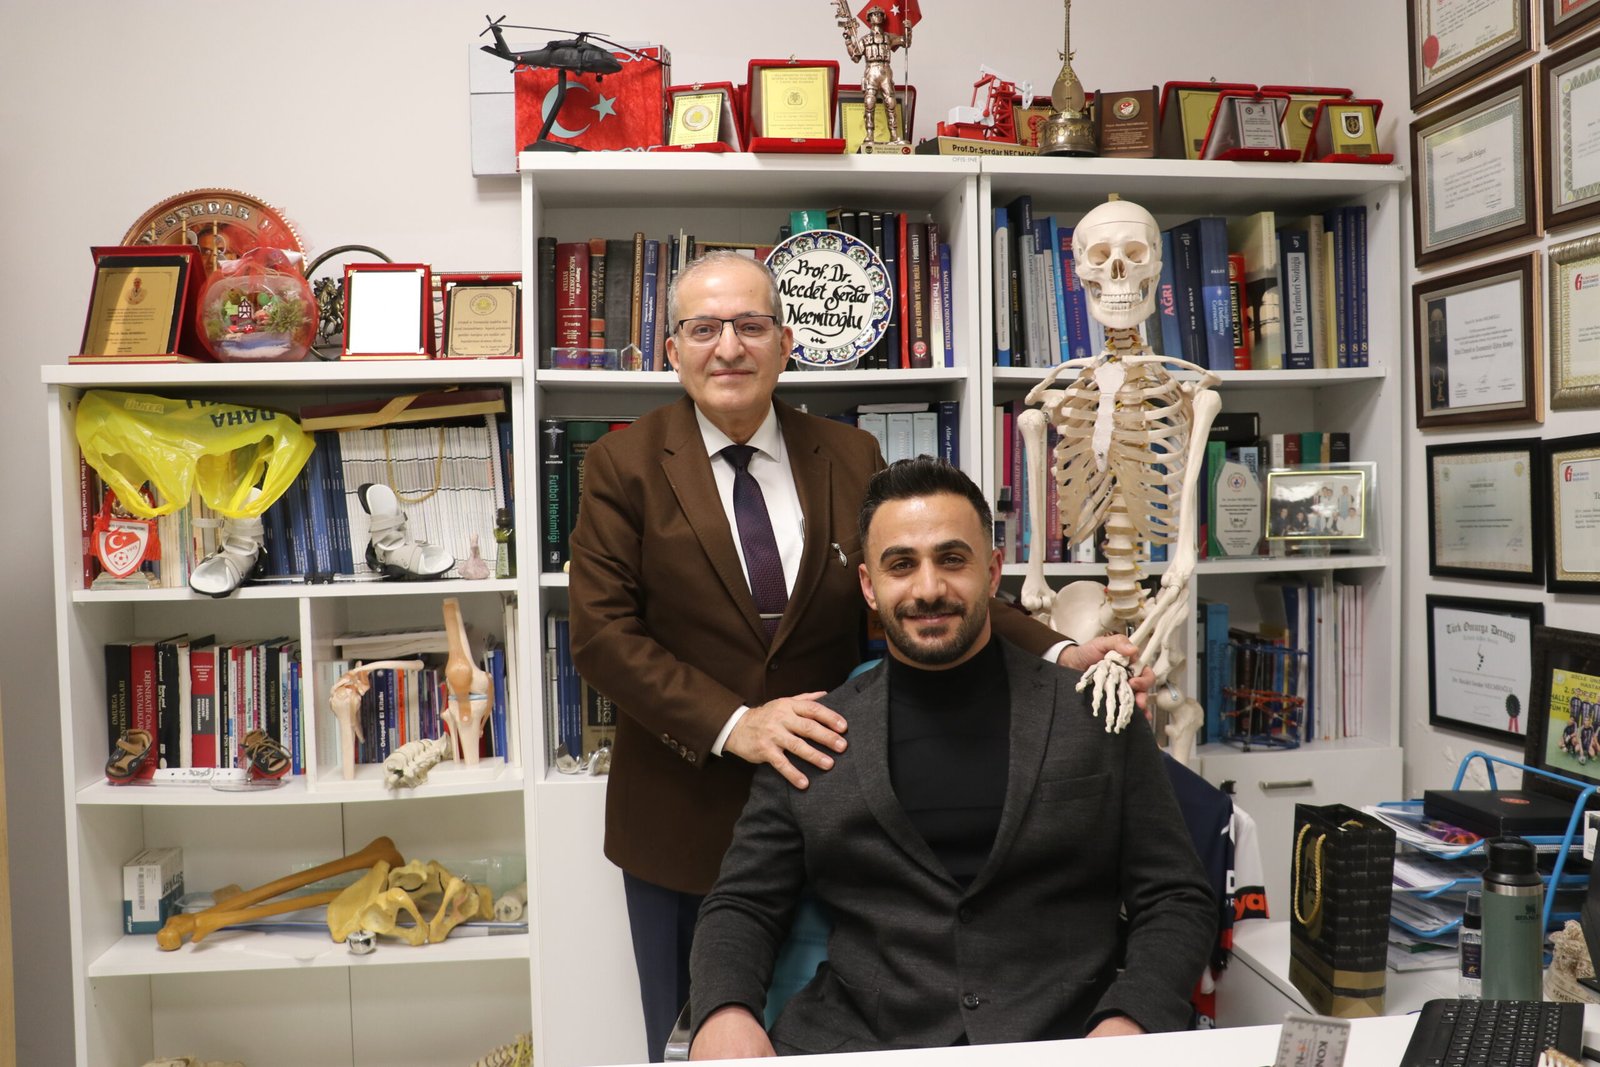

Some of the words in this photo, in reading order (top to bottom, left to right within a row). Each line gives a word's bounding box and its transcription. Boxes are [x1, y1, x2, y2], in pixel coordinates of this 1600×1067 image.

[165, 201, 251, 227] SERDAR
[785, 259, 827, 280] Prof.
[828, 264, 853, 283] Dr.
[779, 276, 826, 300] Necdet
[1160, 283, 1175, 316] AĞRI
[786, 303, 863, 334] Necmioğlu
[1294, 329, 1304, 350] Temel
[210, 408, 275, 428] DAHA
[549, 475, 559, 502] Futbol
[548, 503, 560, 543] Hekimliği
[379, 720, 387, 747] Ortopedi
